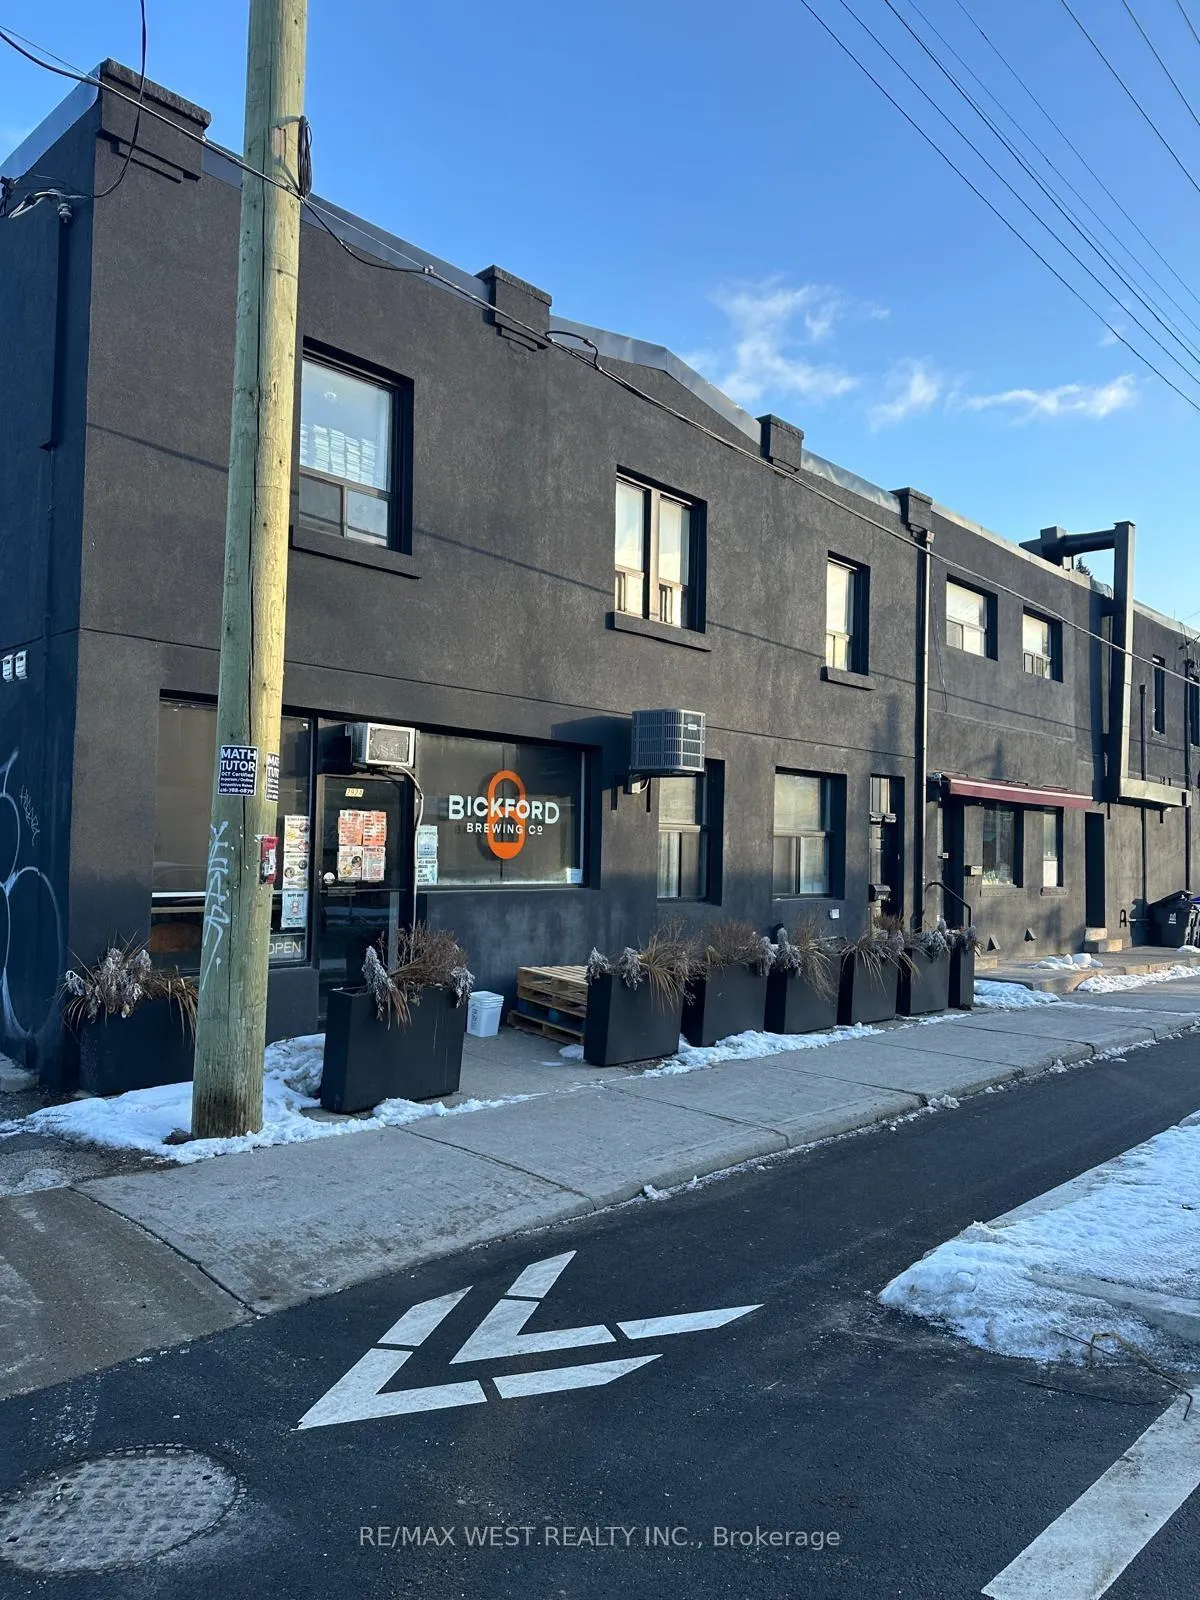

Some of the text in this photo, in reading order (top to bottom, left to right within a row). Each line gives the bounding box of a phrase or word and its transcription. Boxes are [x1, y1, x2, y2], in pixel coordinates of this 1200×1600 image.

[221, 749, 257, 760] MATH
[220, 761, 256, 772] TUTOR
[448, 794, 560, 825] BICKFORD
[466, 822, 524, 835] BREWING
[268, 940, 301, 955] OPEN
